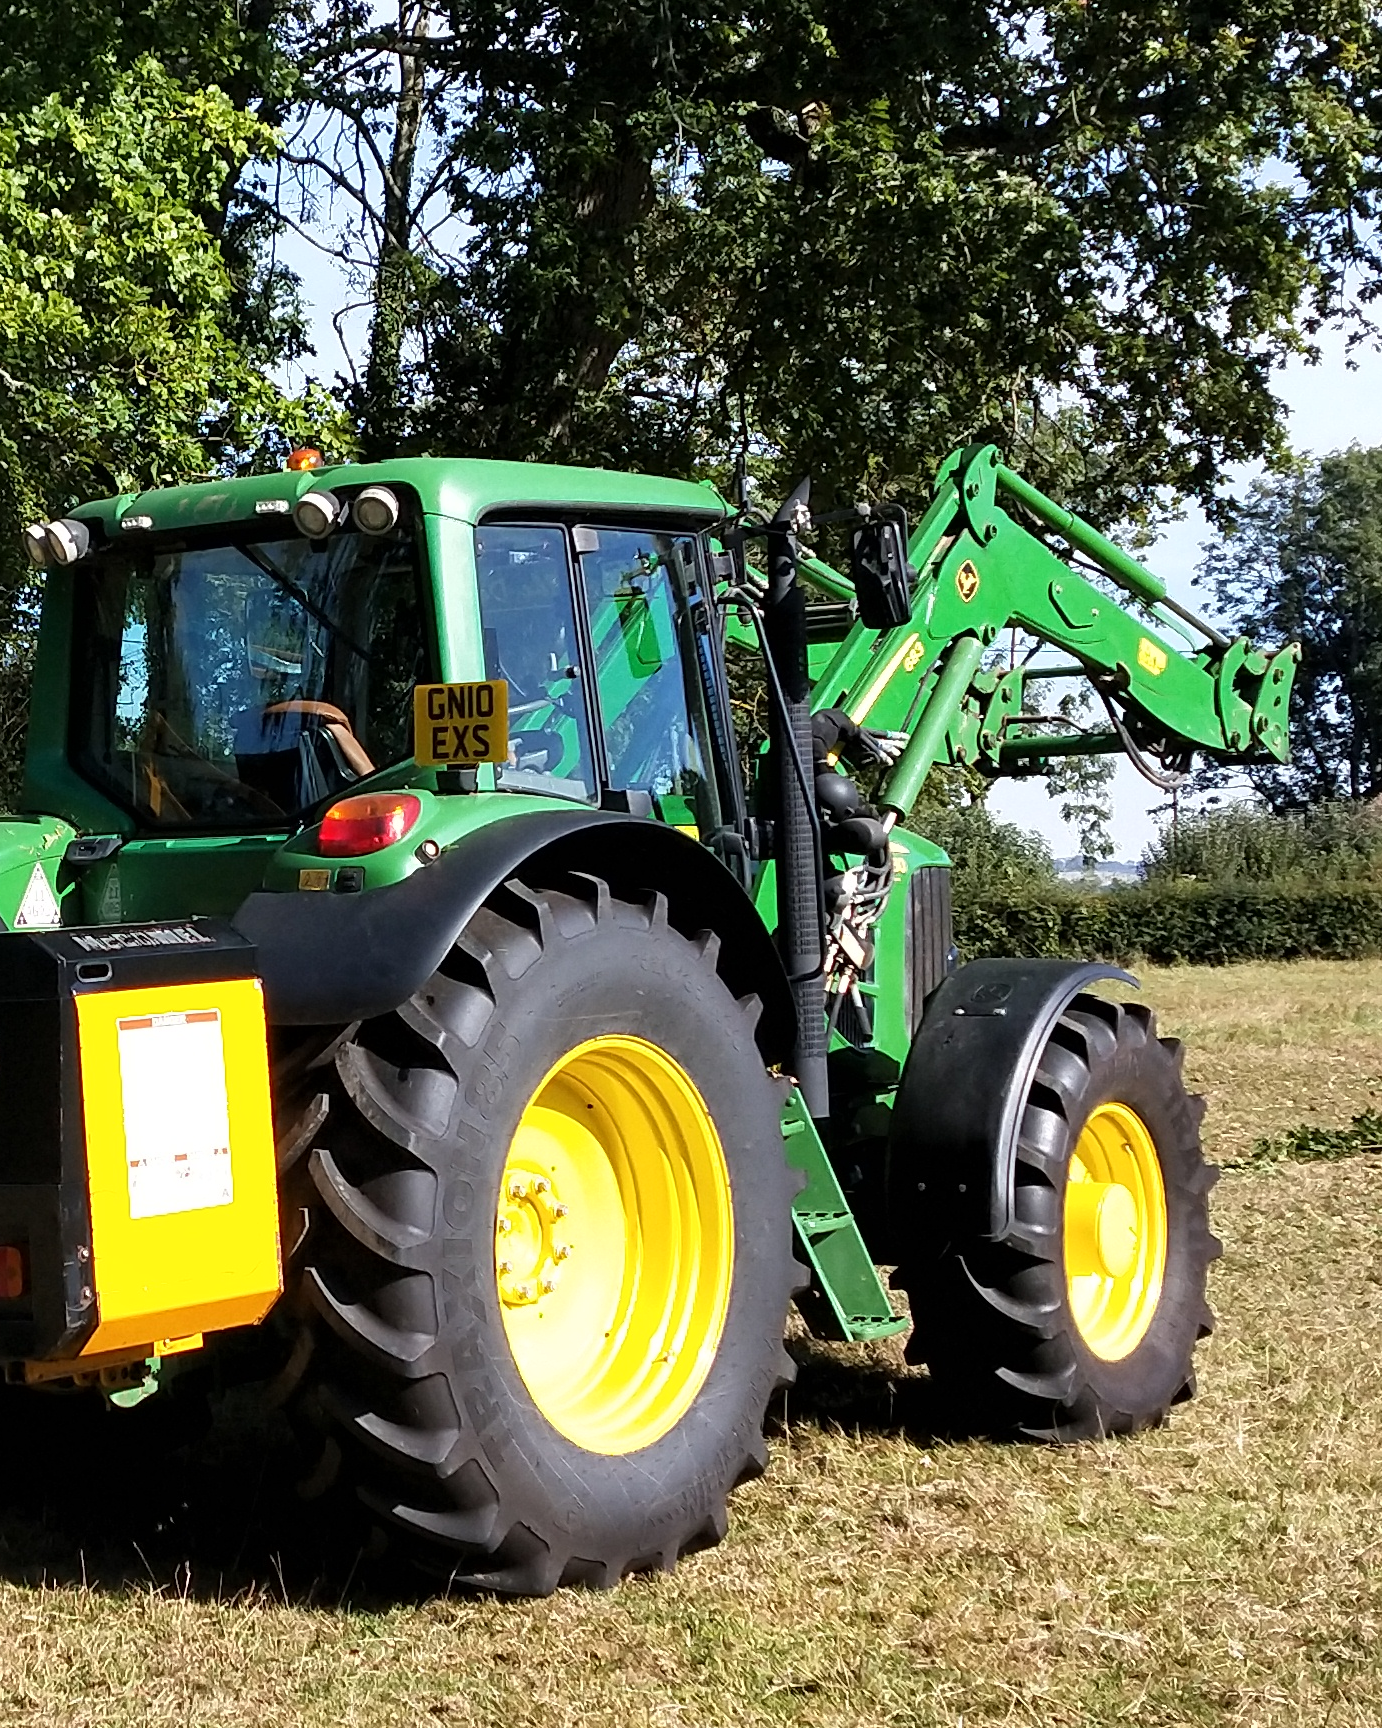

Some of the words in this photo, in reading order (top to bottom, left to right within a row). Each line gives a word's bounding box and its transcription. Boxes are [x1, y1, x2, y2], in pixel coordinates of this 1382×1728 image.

[428, 684, 494, 720] GN10
[432, 724, 490, 760] EXS
[70, 924, 217, 952] McCONNEL
